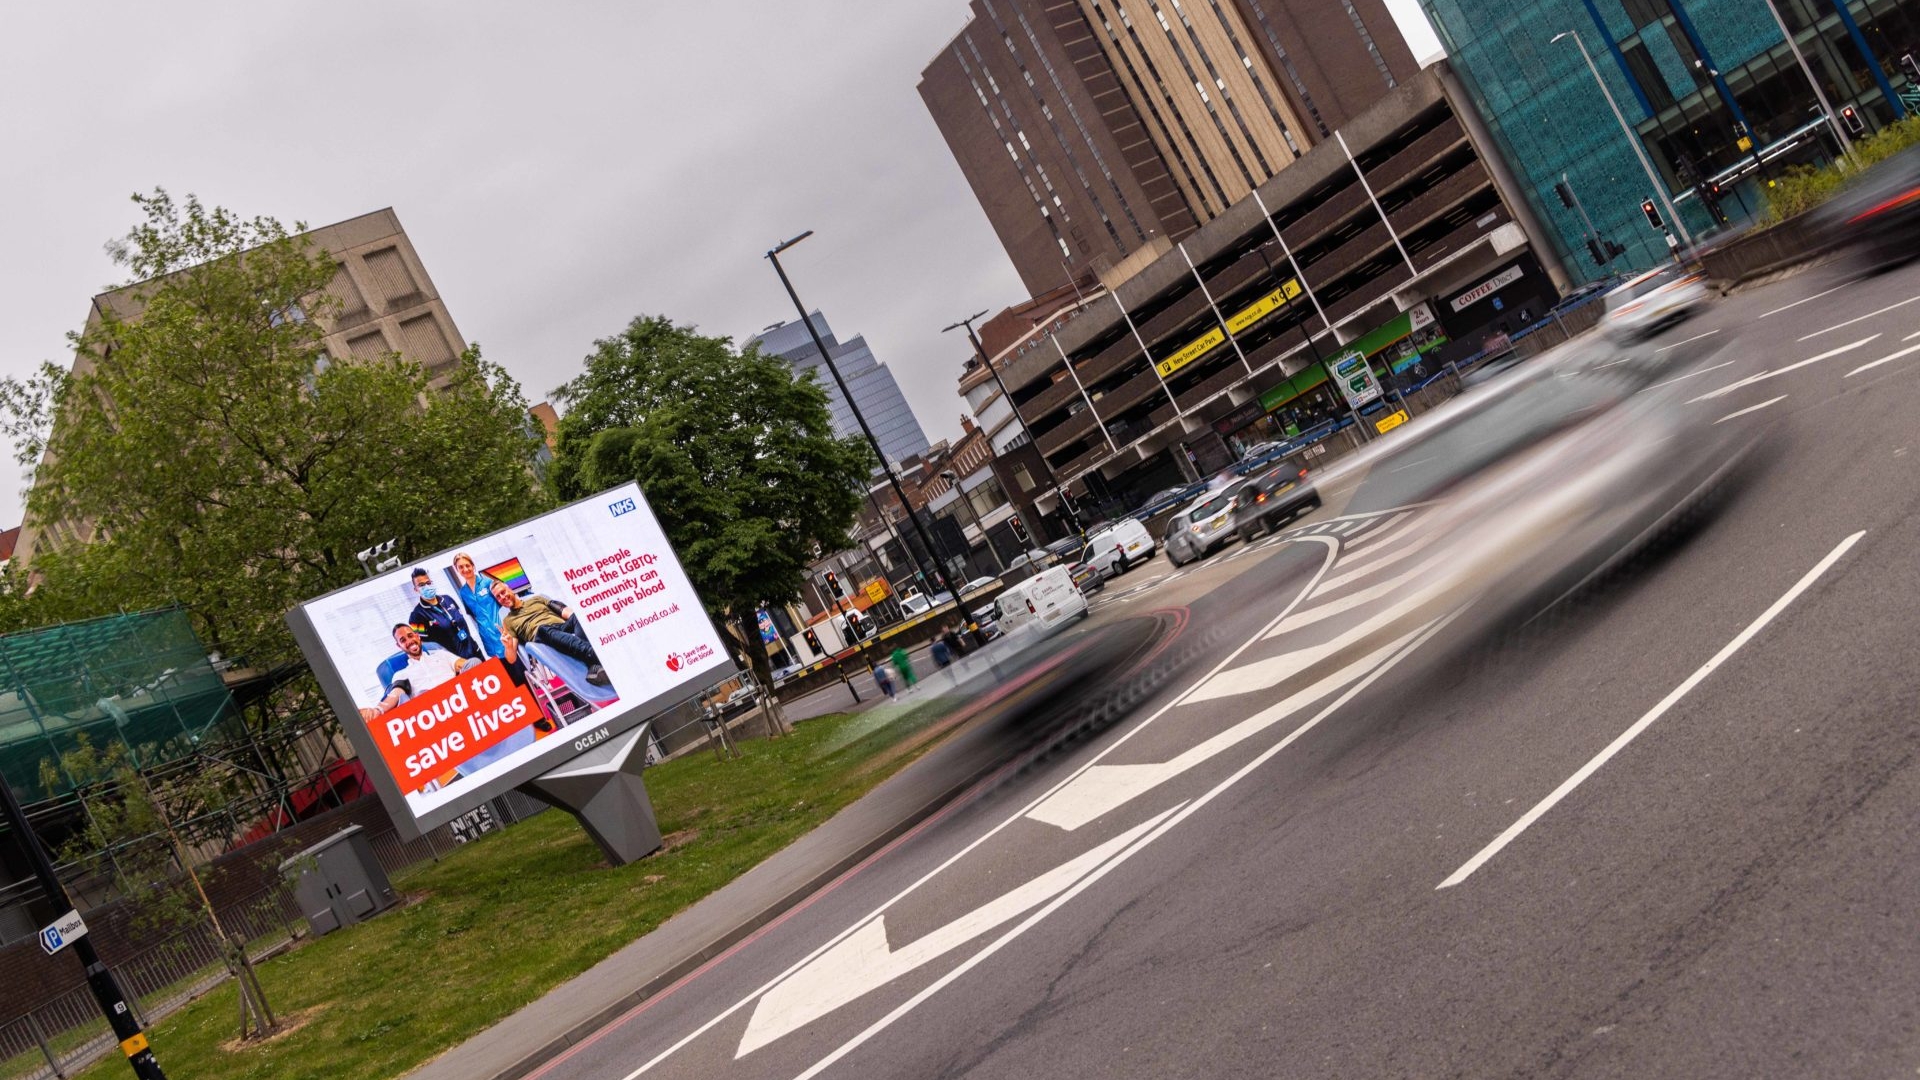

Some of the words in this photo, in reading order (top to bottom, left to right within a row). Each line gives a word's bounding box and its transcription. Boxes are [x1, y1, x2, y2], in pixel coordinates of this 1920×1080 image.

[1459, 283, 1492, 305] COFFEE
[1414, 308, 1424, 319] 24
[1416, 316, 1430, 326] Hours
[1173, 355, 1183, 365] New
[1182, 346, 1198, 361] Street
[1198, 341, 1206, 352] Car
[1206, 336, 1216, 347] Park
[610, 500, 634, 517] NHS
[563, 566, 594, 582] More
[595, 548, 631, 570] people
[571, 578, 599, 595] from
[601, 569, 618, 583] the
[620, 554, 658, 575] LGBTQ+
[579, 578, 638, 608] community
[640, 569, 658, 583] can
[586, 607, 610, 622] now
[612, 595, 635, 613] give
[636, 580, 666, 601] blood
[599, 633, 616, 646] Join
[617, 628, 627, 638] us
[627, 624, 636, 633] at
[636, 602, 680, 630] blood.co.uk
[683, 649, 696, 659] Save
[695, 644, 707, 653] lives
[687, 657, 699, 666] Give
[698, 648, 714, 660] blood
[386, 683, 469, 747] Proud
[471, 674, 500, 700] to
[405, 731, 465, 778] save
[467, 696, 527, 741] lives
[575, 727, 609, 751] OCEAN
[50, 930, 58, 946] P
[59, 919, 82, 937] Mailbox
[117, 1003, 125, 1012] 9
